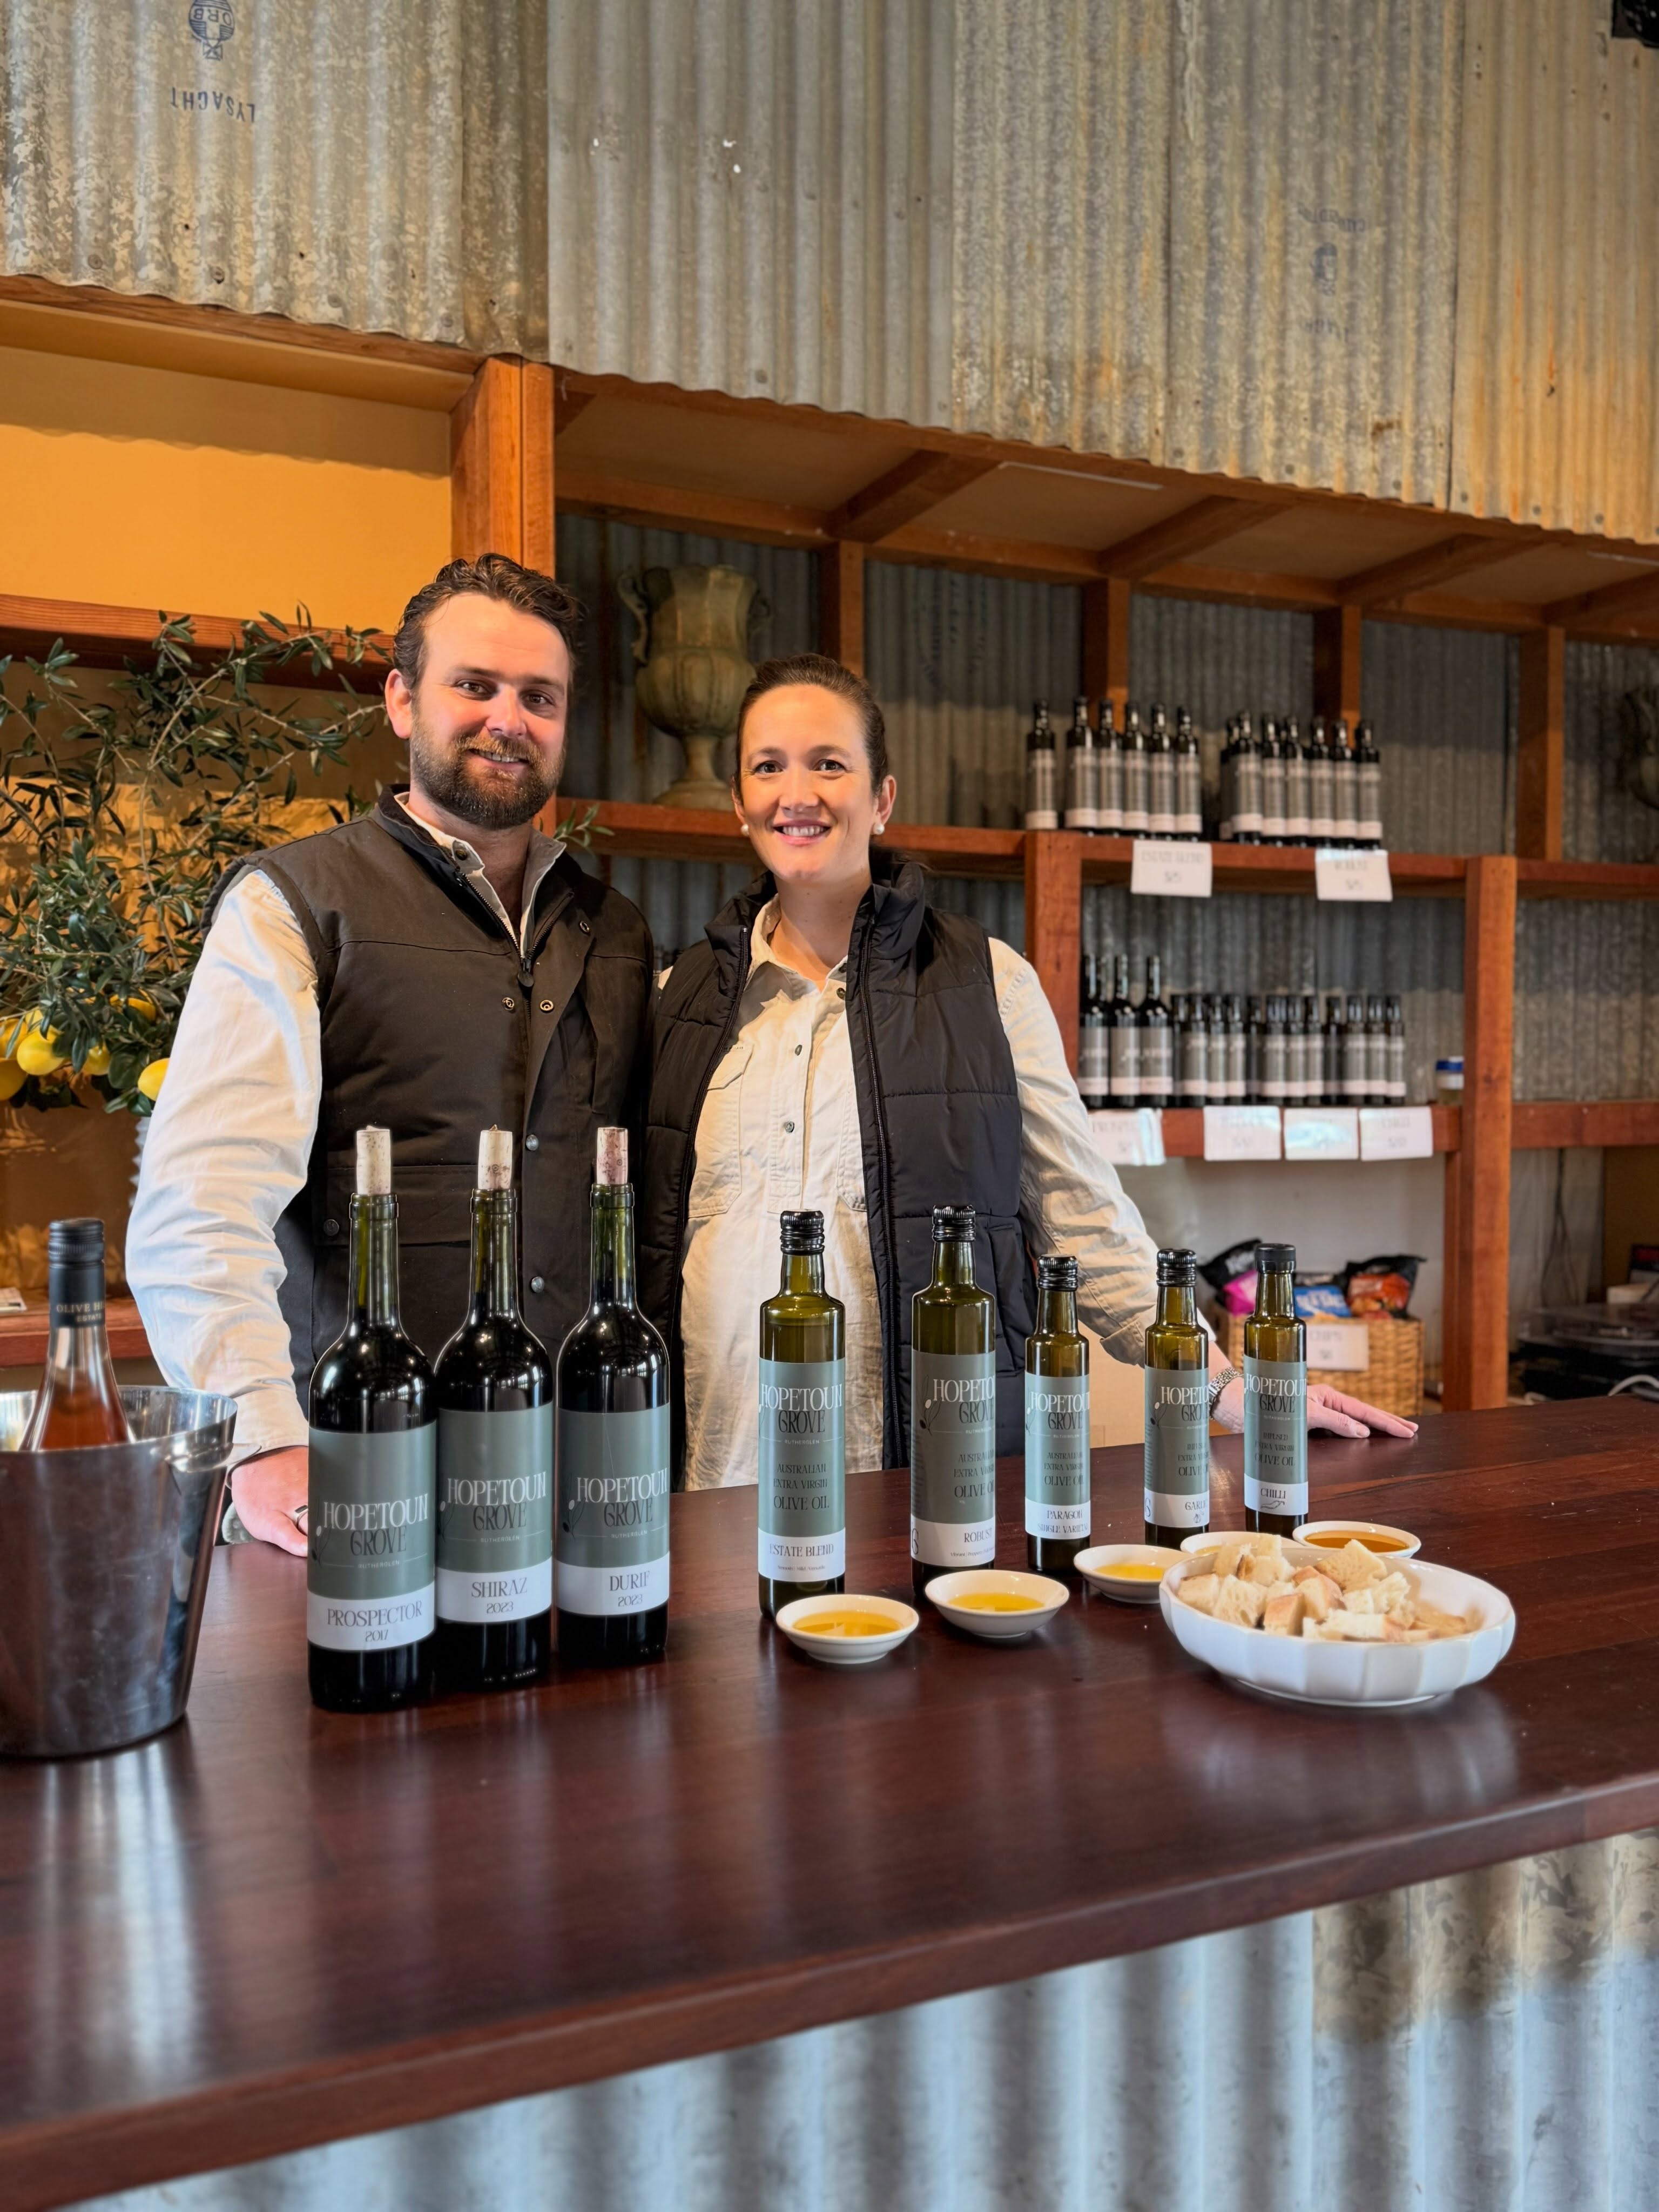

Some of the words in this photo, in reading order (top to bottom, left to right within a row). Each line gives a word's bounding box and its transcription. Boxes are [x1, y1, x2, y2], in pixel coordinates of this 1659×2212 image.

[193, 8, 234, 26] ORB
[56, 1303, 91, 1313] OLIVE
[933, 1375, 995, 1402] HOPETO
[761, 1384, 842, 1412] HOPETOUN
[1259, 1394, 1296, 1413] GROVE
[1048, 1411, 1083, 1430] GROVE
[1181, 1404, 1207, 1421] GRO
[778, 1410, 825, 1434] GROVE
[777, 1463, 826, 1474] AUSTRALIAN
[1044, 1462, 1063, 1471] EXTRA
[1282, 1456, 1295, 1466] OIL
[954, 1468, 978, 1478] EXTRA
[1044, 1475, 1071, 1486] OLIVE
[447, 1471, 547, 1506] HOPETOUN
[577, 1467, 667, 1503] HOPETOUN
[773, 1478, 798, 1489] EXTRA
[801, 1478, 827, 1489] VIRGIN
[954, 1483, 986, 1499] OLIVE
[1260, 1487, 1286, 1499] CHILLI
[773, 1495, 808, 1510] OLIVE
[811, 1495, 830, 1509] OIL
[1185, 1500, 1206, 1510] GARLI
[324, 1493, 428, 1530] HOPETOUN
[473, 1502, 527, 1531] GROVE
[604, 1498, 653, 1527] GROVE
[1047, 1509, 1083, 1520] PARAGON
[350, 1525, 407, 1556] GROVE
[963, 1527, 993, 1543] ROBUST
[769, 1543, 802, 1557] ESTATE
[806, 1543, 834, 1557] BLEND
[471, 1577, 528, 1598] SHIRAZ
[609, 1570, 650, 1591] DURIF
[486, 1601, 514, 1614] 2023
[618, 1594, 643, 1607] 2023
[327, 1600, 422, 1627] PROSPECTOR
[365, 1629, 389, 1642] 2017
